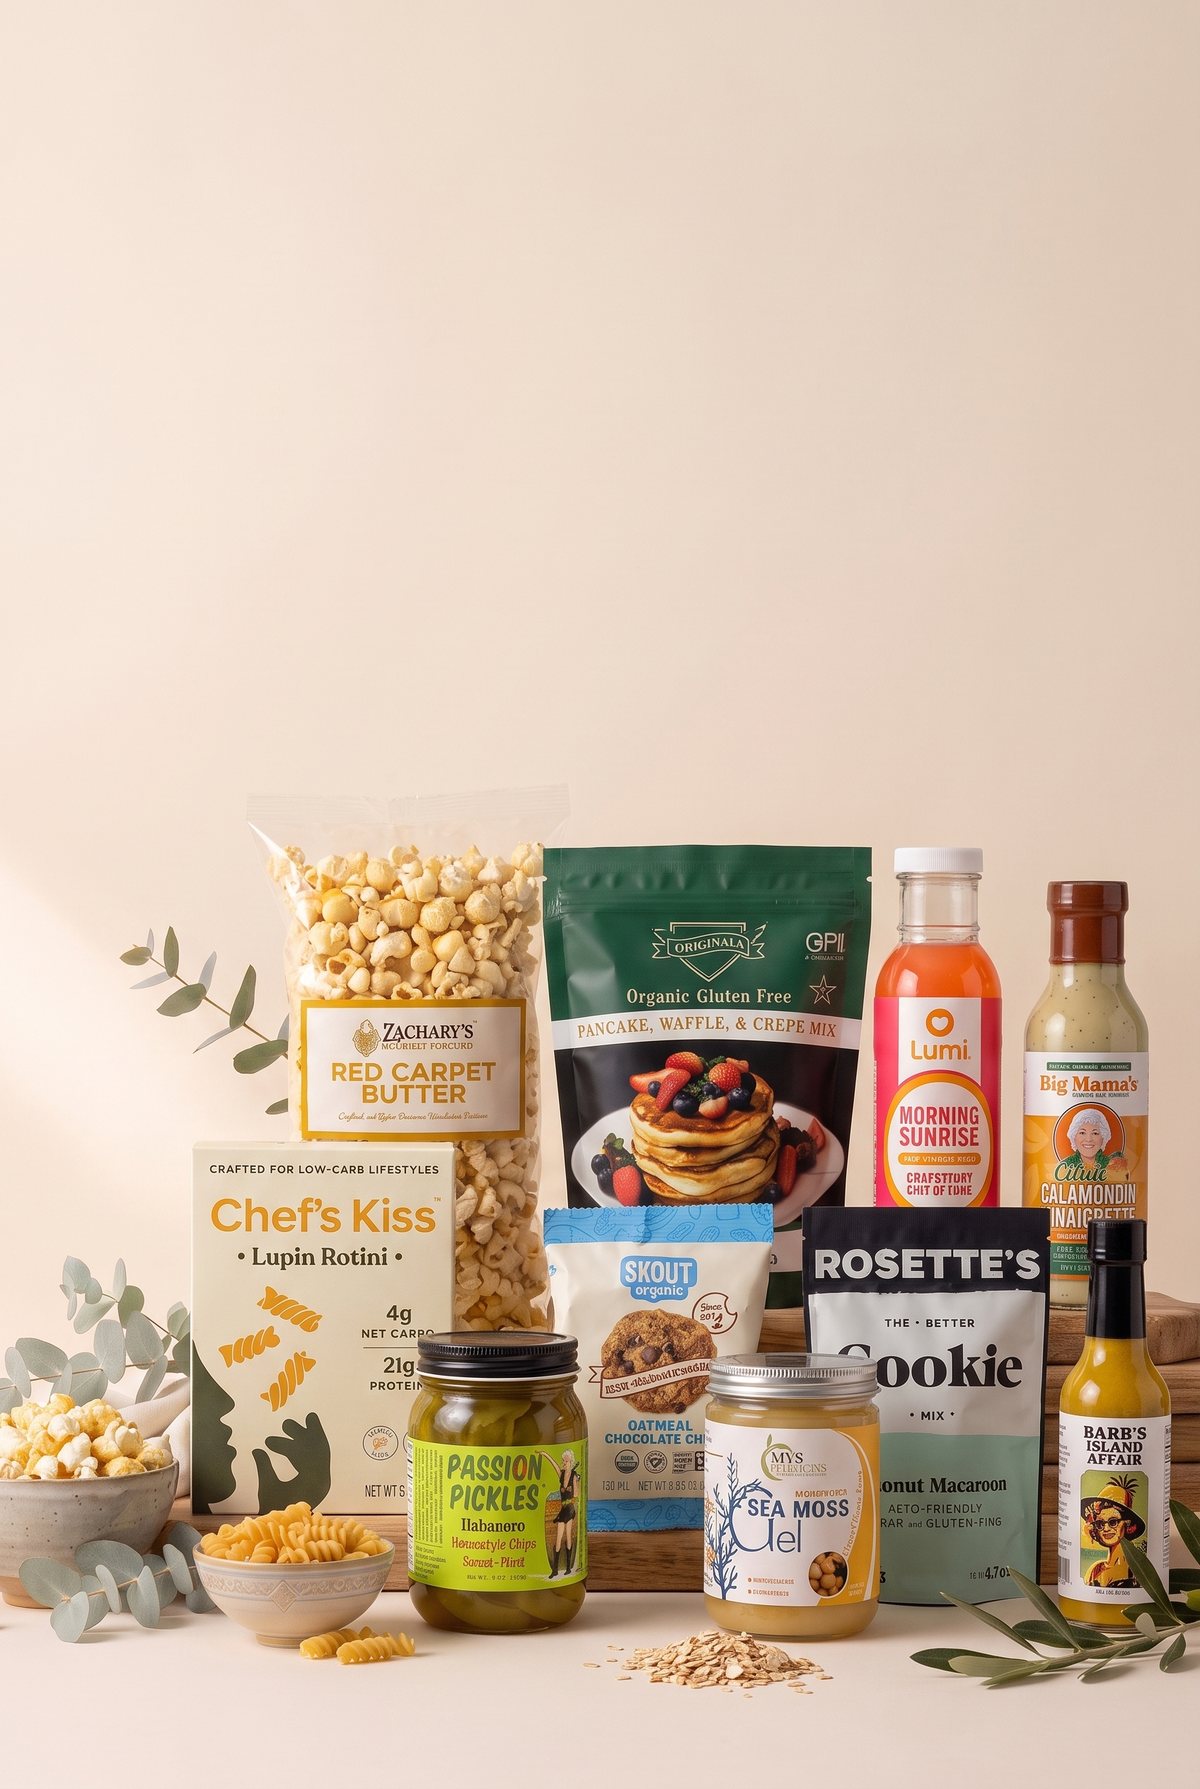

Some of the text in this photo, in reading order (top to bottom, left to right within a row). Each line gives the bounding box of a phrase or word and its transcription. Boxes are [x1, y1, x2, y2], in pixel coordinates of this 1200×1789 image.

[675, 936, 745, 953] ORIGINALA
[626, 988, 792, 1007] Organic Gluten Free
[382, 1022, 474, 1043] ZACHARY'S
[577, 1016, 837, 1039] PANCAKE, WAFFLE, & CREPE MIX
[331, 1061, 496, 1082] RED CARPET
[1040, 1074, 1138, 1096] Big Mama's
[361, 1084, 466, 1104] BUTTER
[899, 1106, 979, 1125] MORNING
[899, 1126, 980, 1147] SUNRISE
[209, 1164, 440, 1175] CRAFTED FOR LOW-CARB LIFESTYLES
[1041, 1183, 1136, 1205] CALAMONDIN
[210, 1197, 342, 1233] Chef's
[352, 1197, 436, 1233] Kiss
[252, 1247, 388, 1270] Lupin Rotini
[814, 1247, 1041, 1281] ROSETTE'S
[624, 1260, 693, 1284] SKOUT
[635, 1285, 684, 1299] organic
[385, 1304, 413, 1325] 4g
[700, 1302, 723, 1312] Since
[884, 1318, 975, 1328] THE BETTER
[361, 1329, 387, 1339] NET
[383, 1356, 415, 1378] 21g
[920, 1411, 945, 1421] MIX
[627, 1419, 694, 1432] OATMEAL
[1083, 1425, 1147, 1440] BARB'S
[604, 1433, 682, 1445] CHOCOLATE
[1086, 1440, 1143, 1453] ISLAND
[771, 1451, 804, 1464] MYS
[1087, 1453, 1143, 1466] AFFAIR
[447, 1453, 543, 1481] PASSION
[365, 1484, 382, 1498] NET
[383, 1484, 397, 1498] WT
[638, 1480, 653, 1491] NET
[655, 1480, 667, 1491] WT
[880, 1477, 1007, 1493] onut Macaroon
[449, 1483, 540, 1512] PICKLES
[747, 1499, 849, 1518] SEA MOSS
[888, 1503, 983, 1514] AETO-FRIENDLY
[926, 1516, 1002, 1528] GLUTEN-FING
[509, 1537, 537, 1553] Chips
